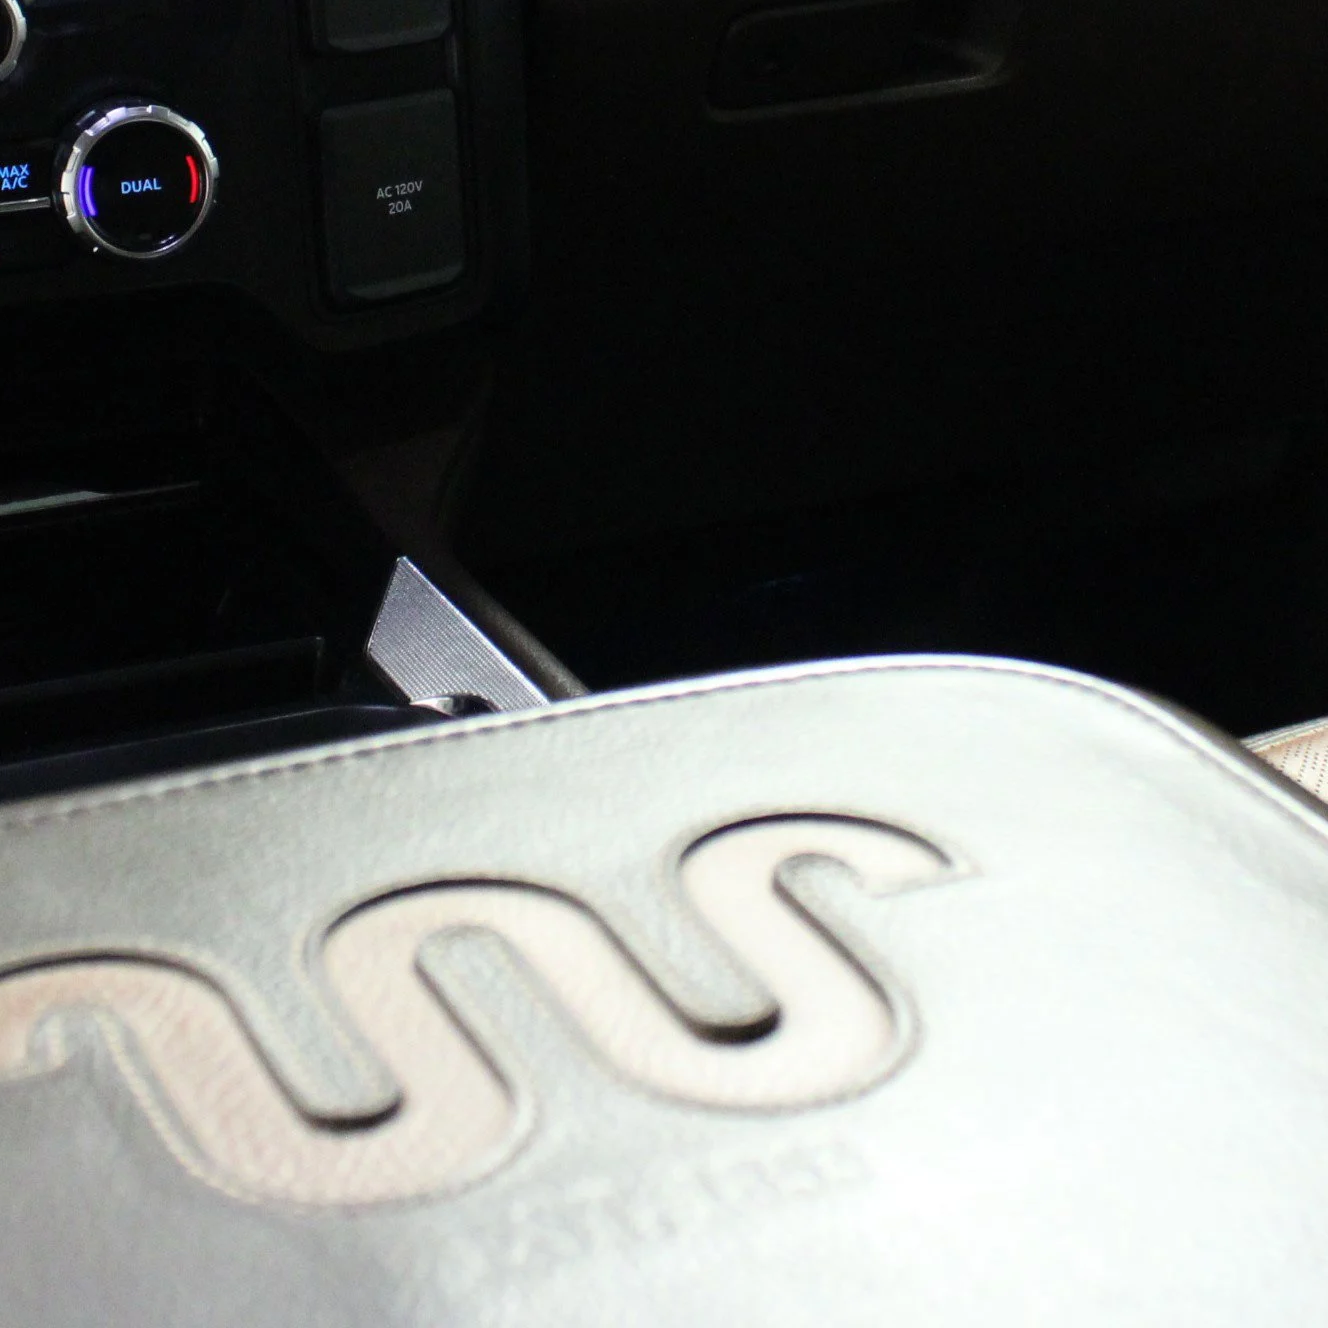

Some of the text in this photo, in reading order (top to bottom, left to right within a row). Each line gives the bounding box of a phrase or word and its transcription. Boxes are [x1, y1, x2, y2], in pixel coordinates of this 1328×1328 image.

[0, 175, 29, 191] A/C
[120, 177, 162, 195] DUAL
[376, 180, 423, 200] AC 120V
[388, 198, 413, 215] 20A
